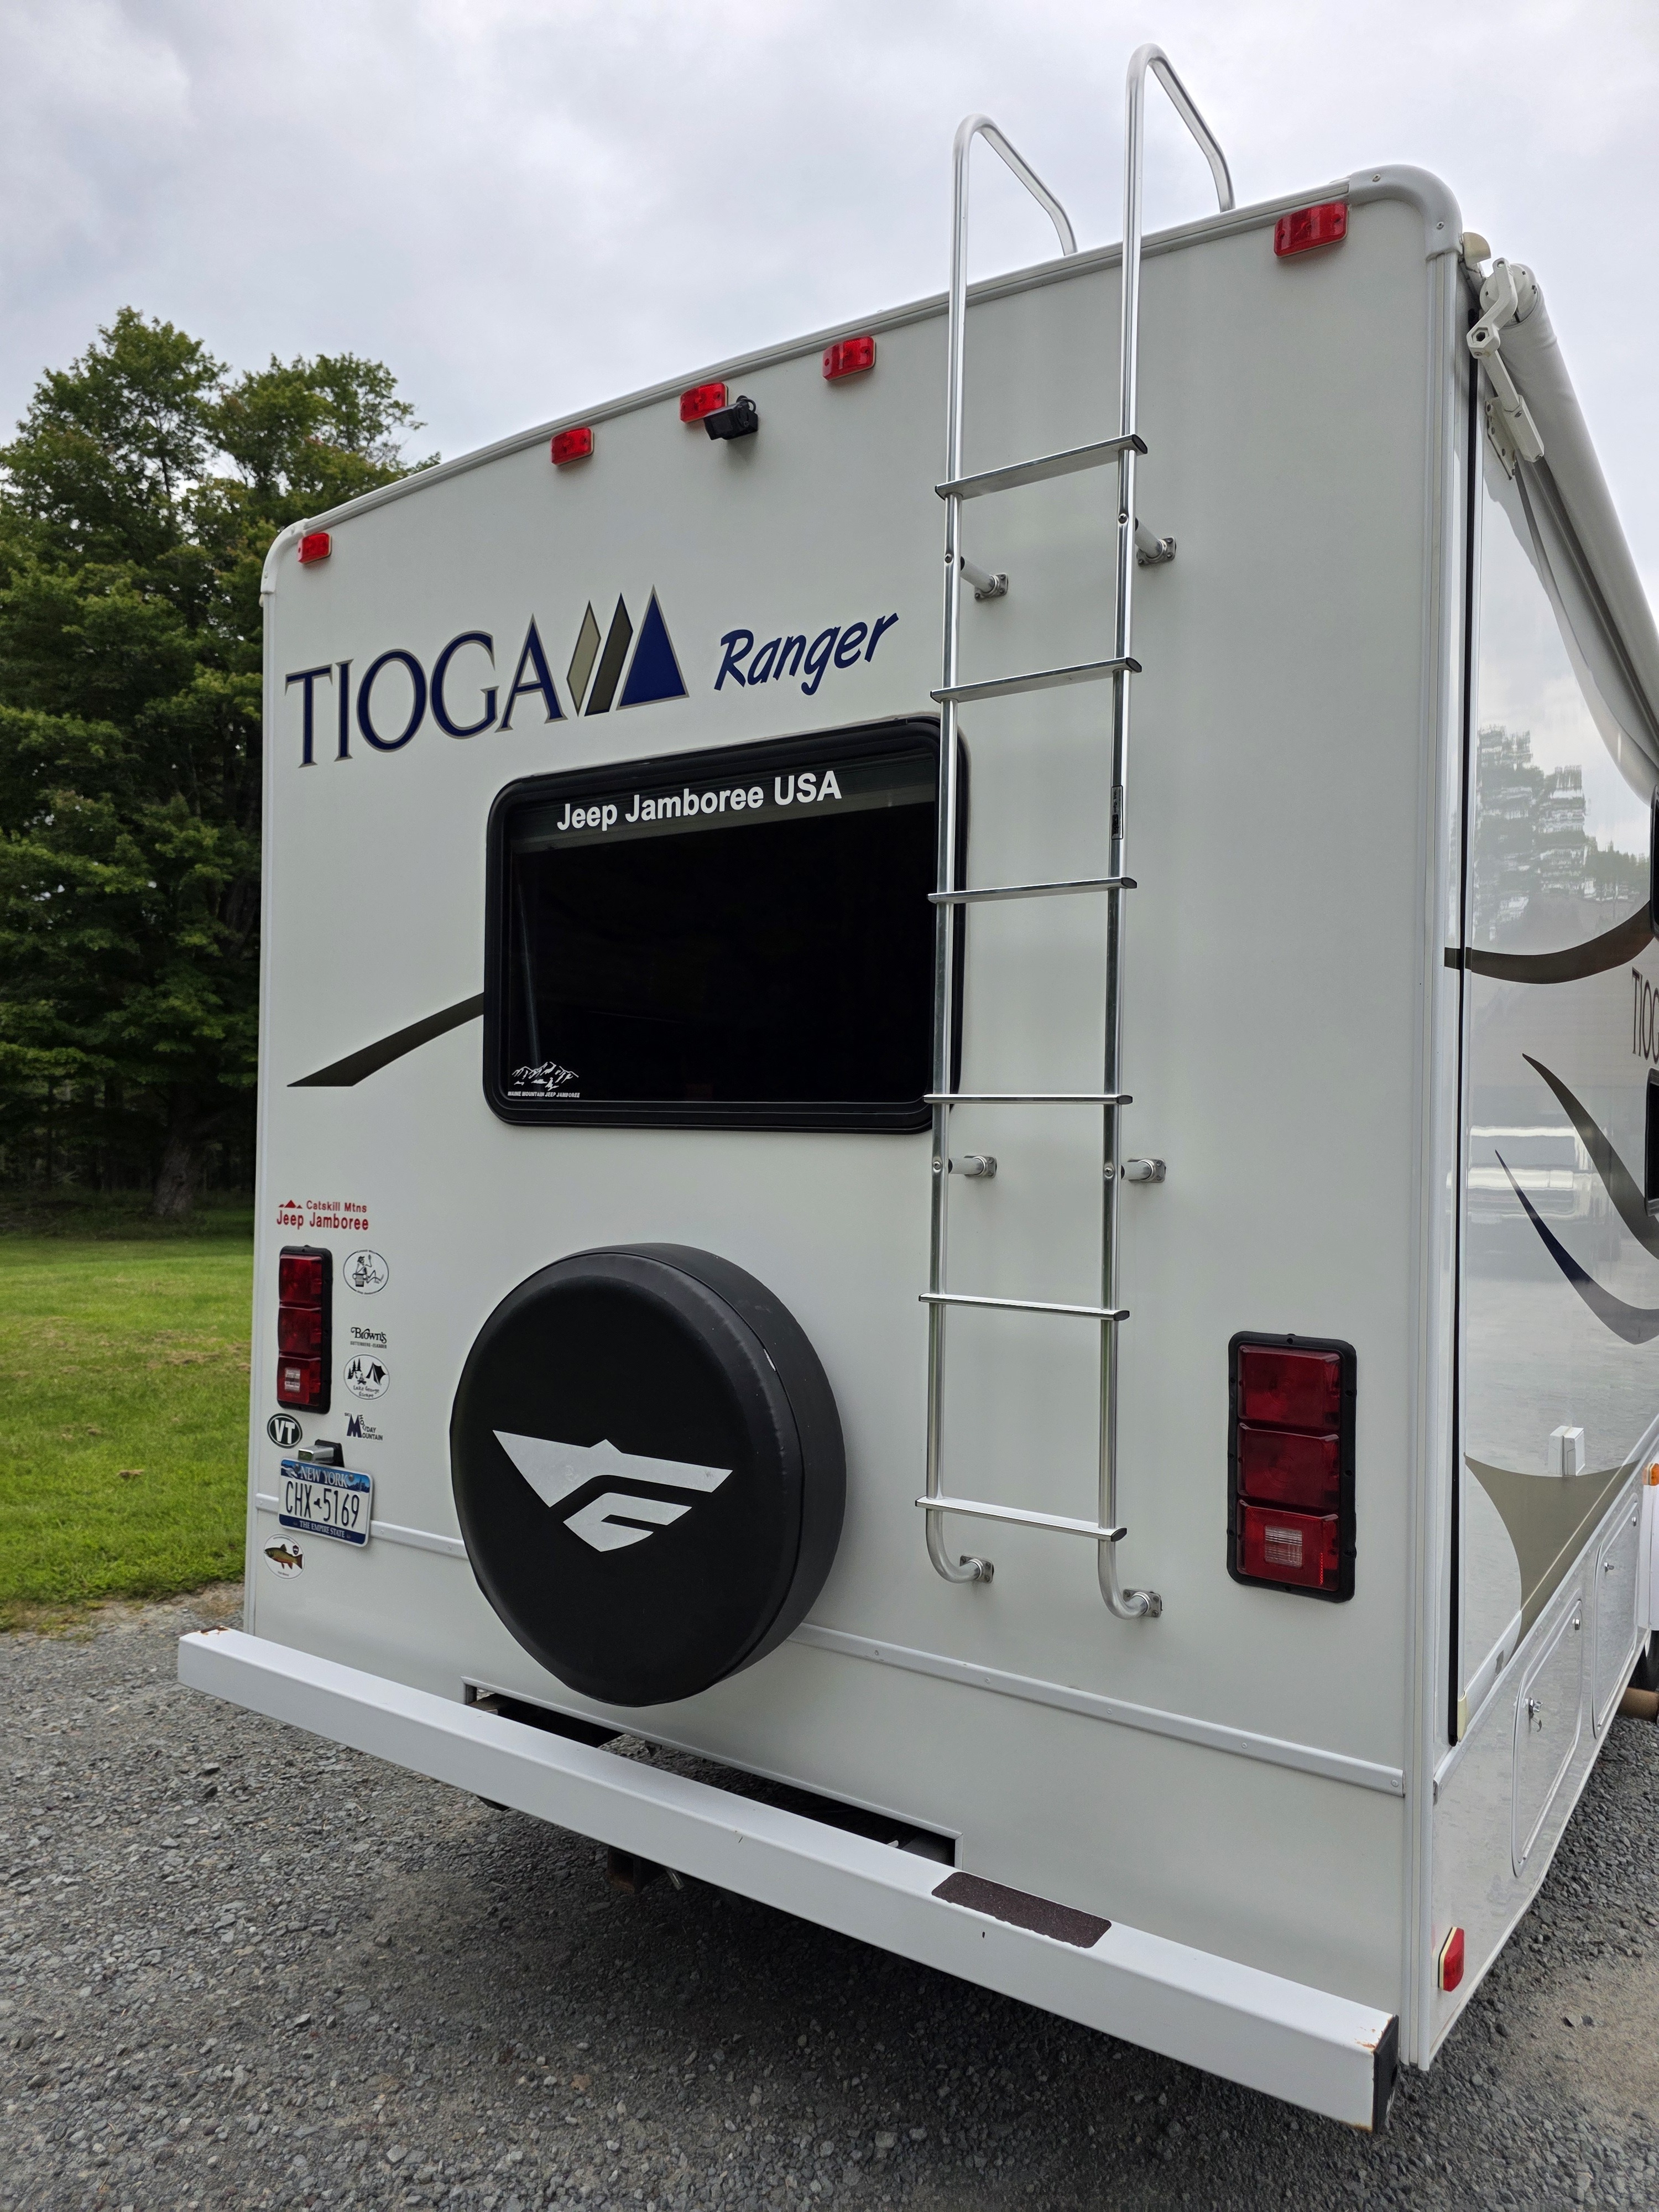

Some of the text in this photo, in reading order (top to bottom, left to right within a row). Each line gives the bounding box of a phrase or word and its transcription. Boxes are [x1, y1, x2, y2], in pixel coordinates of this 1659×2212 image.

[714, 613, 899, 696] Ranger
[285, 613, 568, 768] TIOGA
[557, 770, 842, 831] Jeep Jamboree USA
[306, 1200, 367, 1213] Catskill Mtns
[276, 1210, 369, 1230] Jeep Jamboree
[351, 1327, 387, 1344] Brown's
[274, 1419, 295, 1444] VT
[300, 1466, 348, 1488] NEW YORK
[299, 1520, 345, 1538] THE EMPIRE STATE
